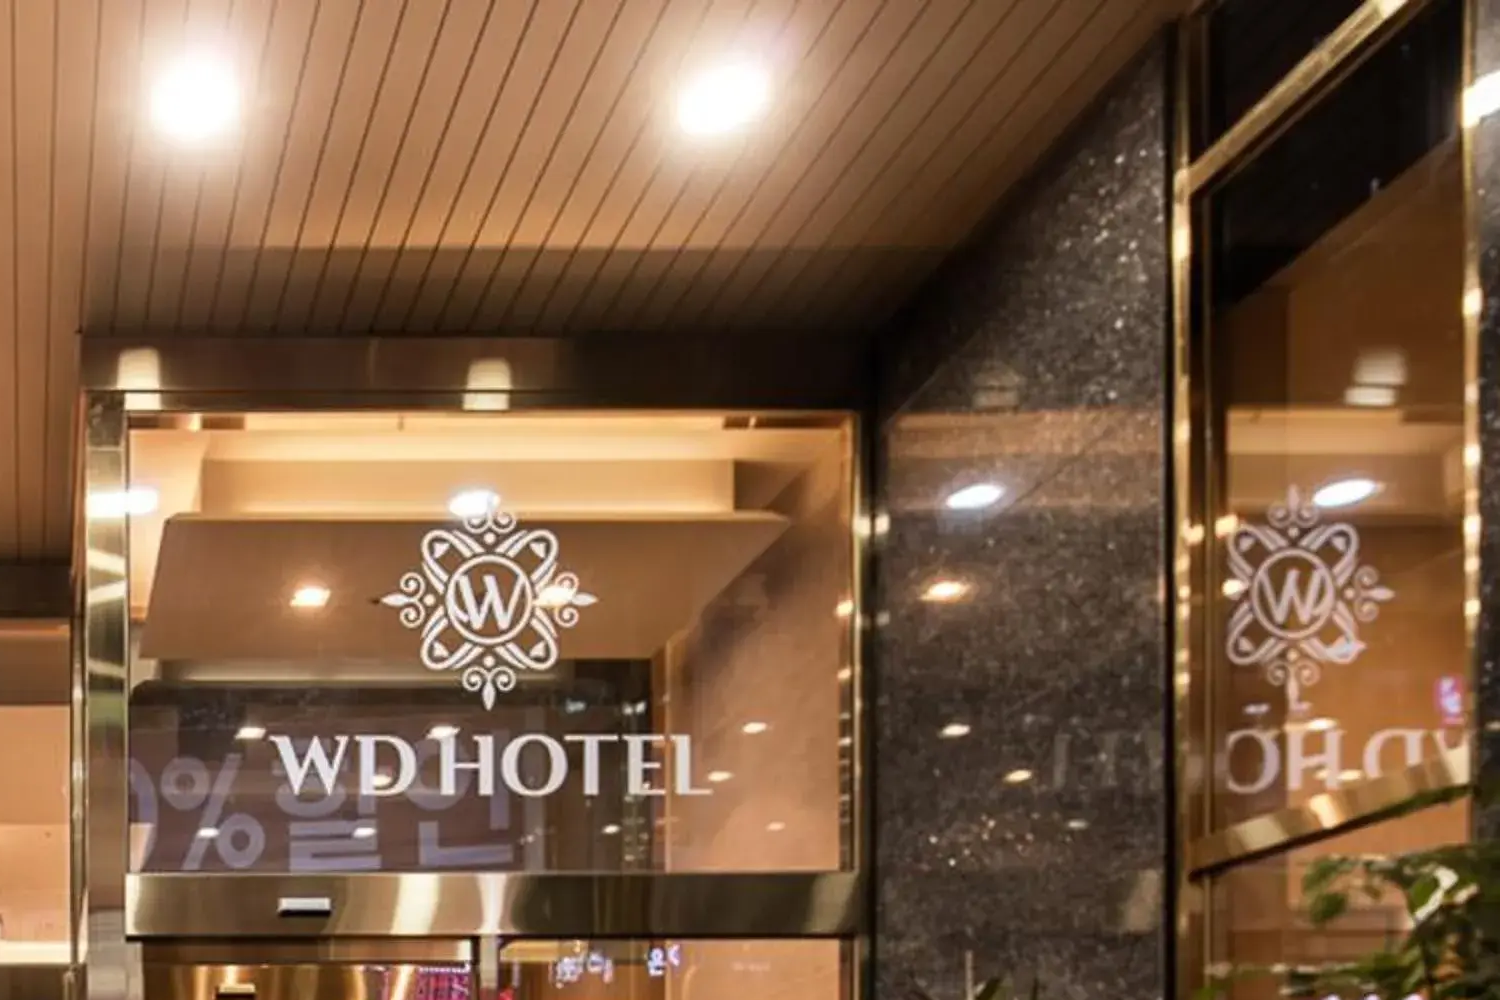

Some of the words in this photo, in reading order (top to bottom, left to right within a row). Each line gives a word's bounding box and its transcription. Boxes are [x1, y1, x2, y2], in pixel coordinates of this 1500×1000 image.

[455, 573, 524, 631] W
[268, 734, 417, 797] WD
[438, 734, 713, 797] HOTEL
